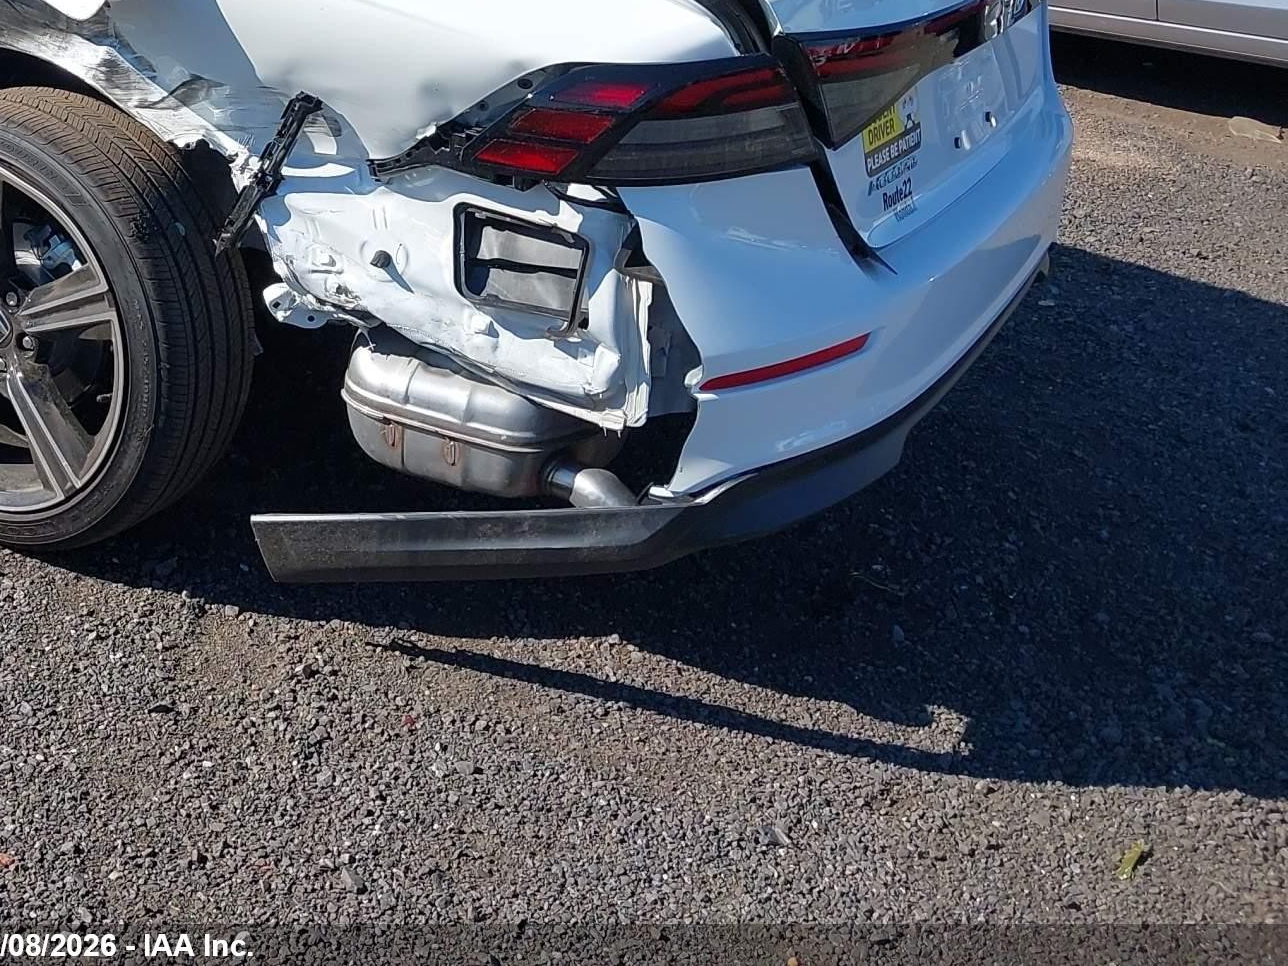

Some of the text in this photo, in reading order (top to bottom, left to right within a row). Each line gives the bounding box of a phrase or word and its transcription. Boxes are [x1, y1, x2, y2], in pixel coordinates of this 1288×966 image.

[868, 118, 895, 146] DRIVER
[867, 128, 921, 172] PLEASE BE PATIENT
[882, 177, 912, 212] Route22
